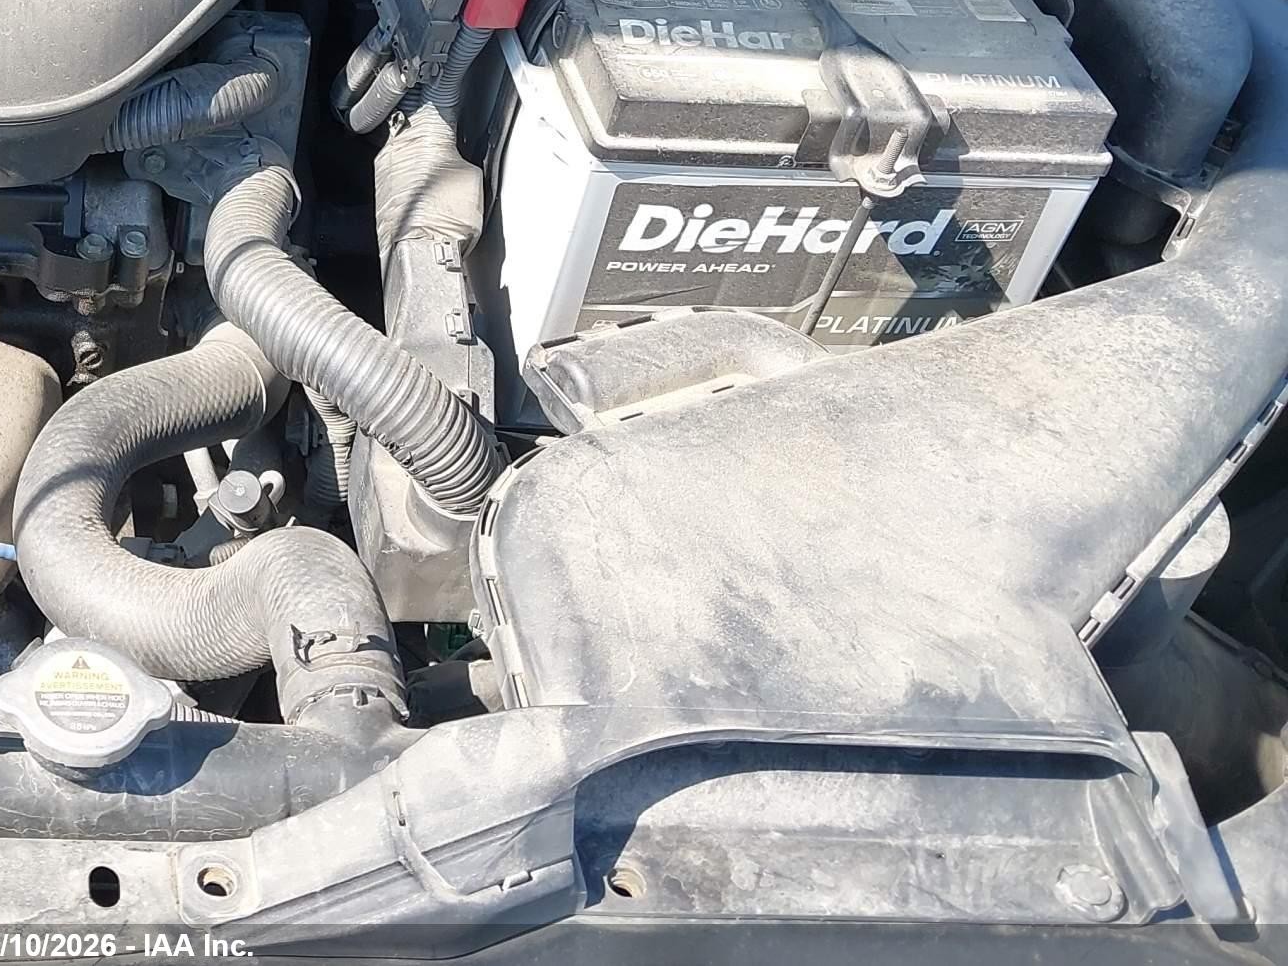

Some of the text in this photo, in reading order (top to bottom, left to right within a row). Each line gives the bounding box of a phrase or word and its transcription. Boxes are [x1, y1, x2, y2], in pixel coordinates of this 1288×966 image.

[926, 73, 1062, 89] PLATINUM
[618, 203, 957, 256] DieHard
[965, 222, 1018, 233] AGM
[605, 261, 772, 274] POWER AHEAD
[55, 671, 110, 681] WARNING
[40, 681, 124, 691] AVERTISSEMENT
